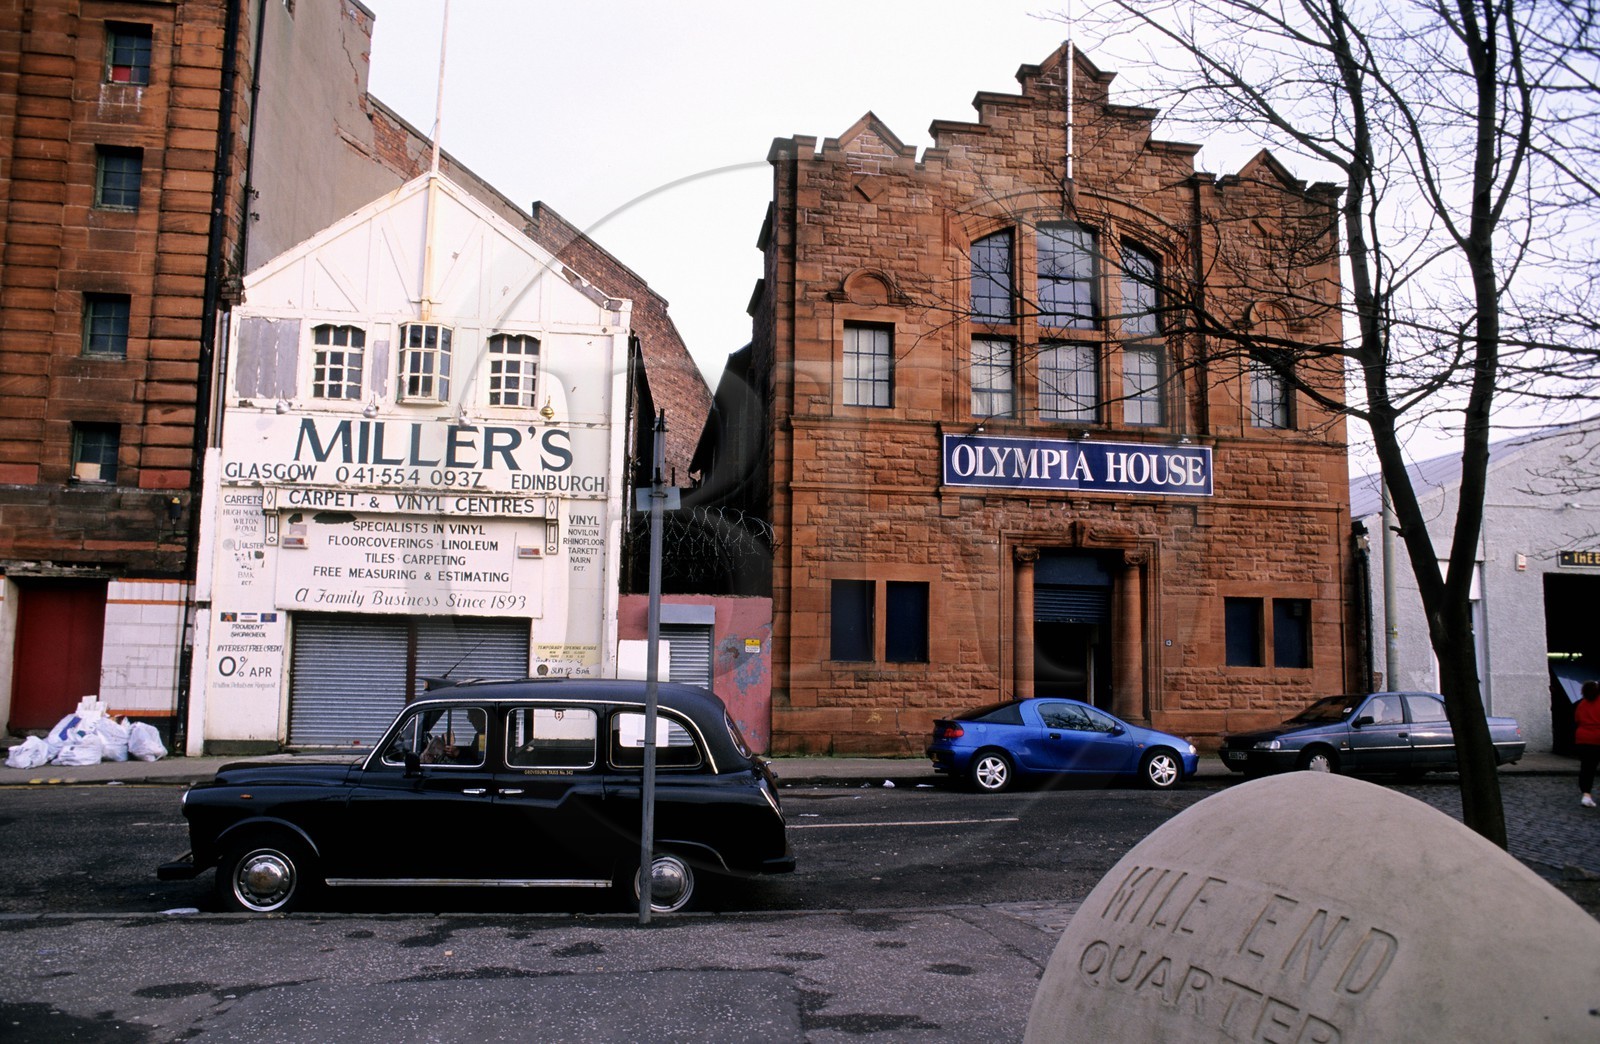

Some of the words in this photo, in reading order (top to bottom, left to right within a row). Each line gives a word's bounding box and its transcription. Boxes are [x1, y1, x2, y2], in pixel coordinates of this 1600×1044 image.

[293, 417, 574, 473] MILLER'S
[951, 444, 1094, 482] OLYMPIA
[1106, 452, 1206, 487] HOUSE
[224, 462, 317, 482] GLASGOW
[430, 469, 483, 488] 0937
[511, 473, 605, 493] EDINBURGH
[223, 495, 263, 505] CARPETS
[288, 489, 359, 507] CARPET
[369, 496, 380, 508] &
[394, 494, 445, 512] VINYL
[455, 498, 535, 514] CENTRES
[568, 514, 600, 526] VINYL
[353, 521, 428, 534] SPECIALISTS
[433, 523, 444, 534] IN
[449, 524, 486, 536] VINYL
[568, 528, 599, 537] NOVILON
[328, 535, 434, 549] FLOORCOVERINGS
[441, 540, 499, 552] LINOLEUM
[562, 537, 605, 547] RHINOFLOOR
[365, 552, 395, 564] TILES
[403, 554, 466, 566] CARPETING
[568, 547, 599, 555] TARKETT
[570, 556, 591, 564] NAIRN
[313, 566, 342, 578] FREE
[348, 568, 417, 580] MEASURING
[424, 572, 432, 581] &
[438, 570, 510, 583] ESTIMATING
[295, 588, 310, 603] A
[315, 588, 365, 608] Family
[372, 590, 439, 607] Business
[446, 593, 486, 609] Since
[490, 595, 527, 610] 1893
[217, 645, 248, 653] INTEREST
[248, 645, 263, 653] FREE
[218, 656, 248, 678] 0%
[249, 666, 272, 678] APR
[1101, 866, 1228, 935] MILE
[1237, 893, 1399, 997] END
